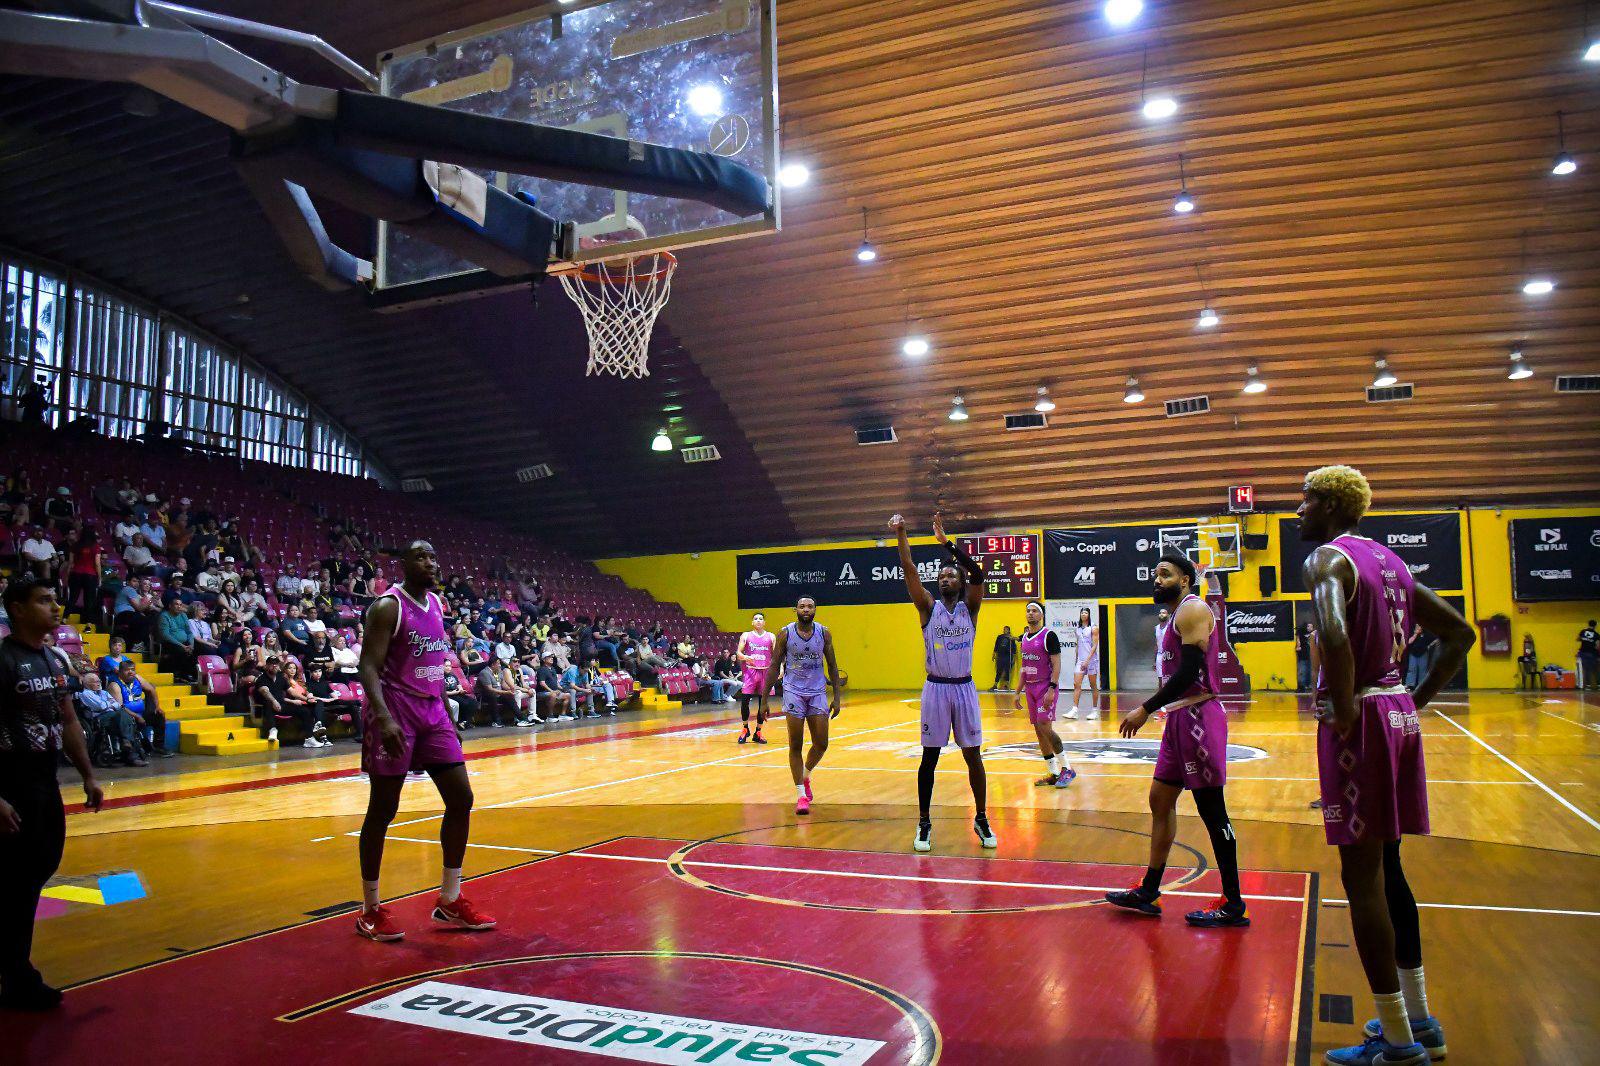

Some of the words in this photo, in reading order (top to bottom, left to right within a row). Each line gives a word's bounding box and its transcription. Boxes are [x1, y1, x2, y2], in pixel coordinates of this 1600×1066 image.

[1237, 488, 1250, 502] 14
[987, 537, 1014, 551] 9:11
[1387, 533, 1427, 544] D'Gari
[1022, 541, 1029, 552] 2
[1077, 541, 1117, 554] Coppel
[993, 560, 1000, 569] 2
[1014, 560, 1031, 575] 20
[988, 583, 998, 594] 13
[1024, 582, 1032, 593] 0
[585, 1007, 648, 1023] todos
[661, 1018, 712, 1030] para
[721, 1026, 747, 1034] es
[755, 1030, 814, 1043] salud
